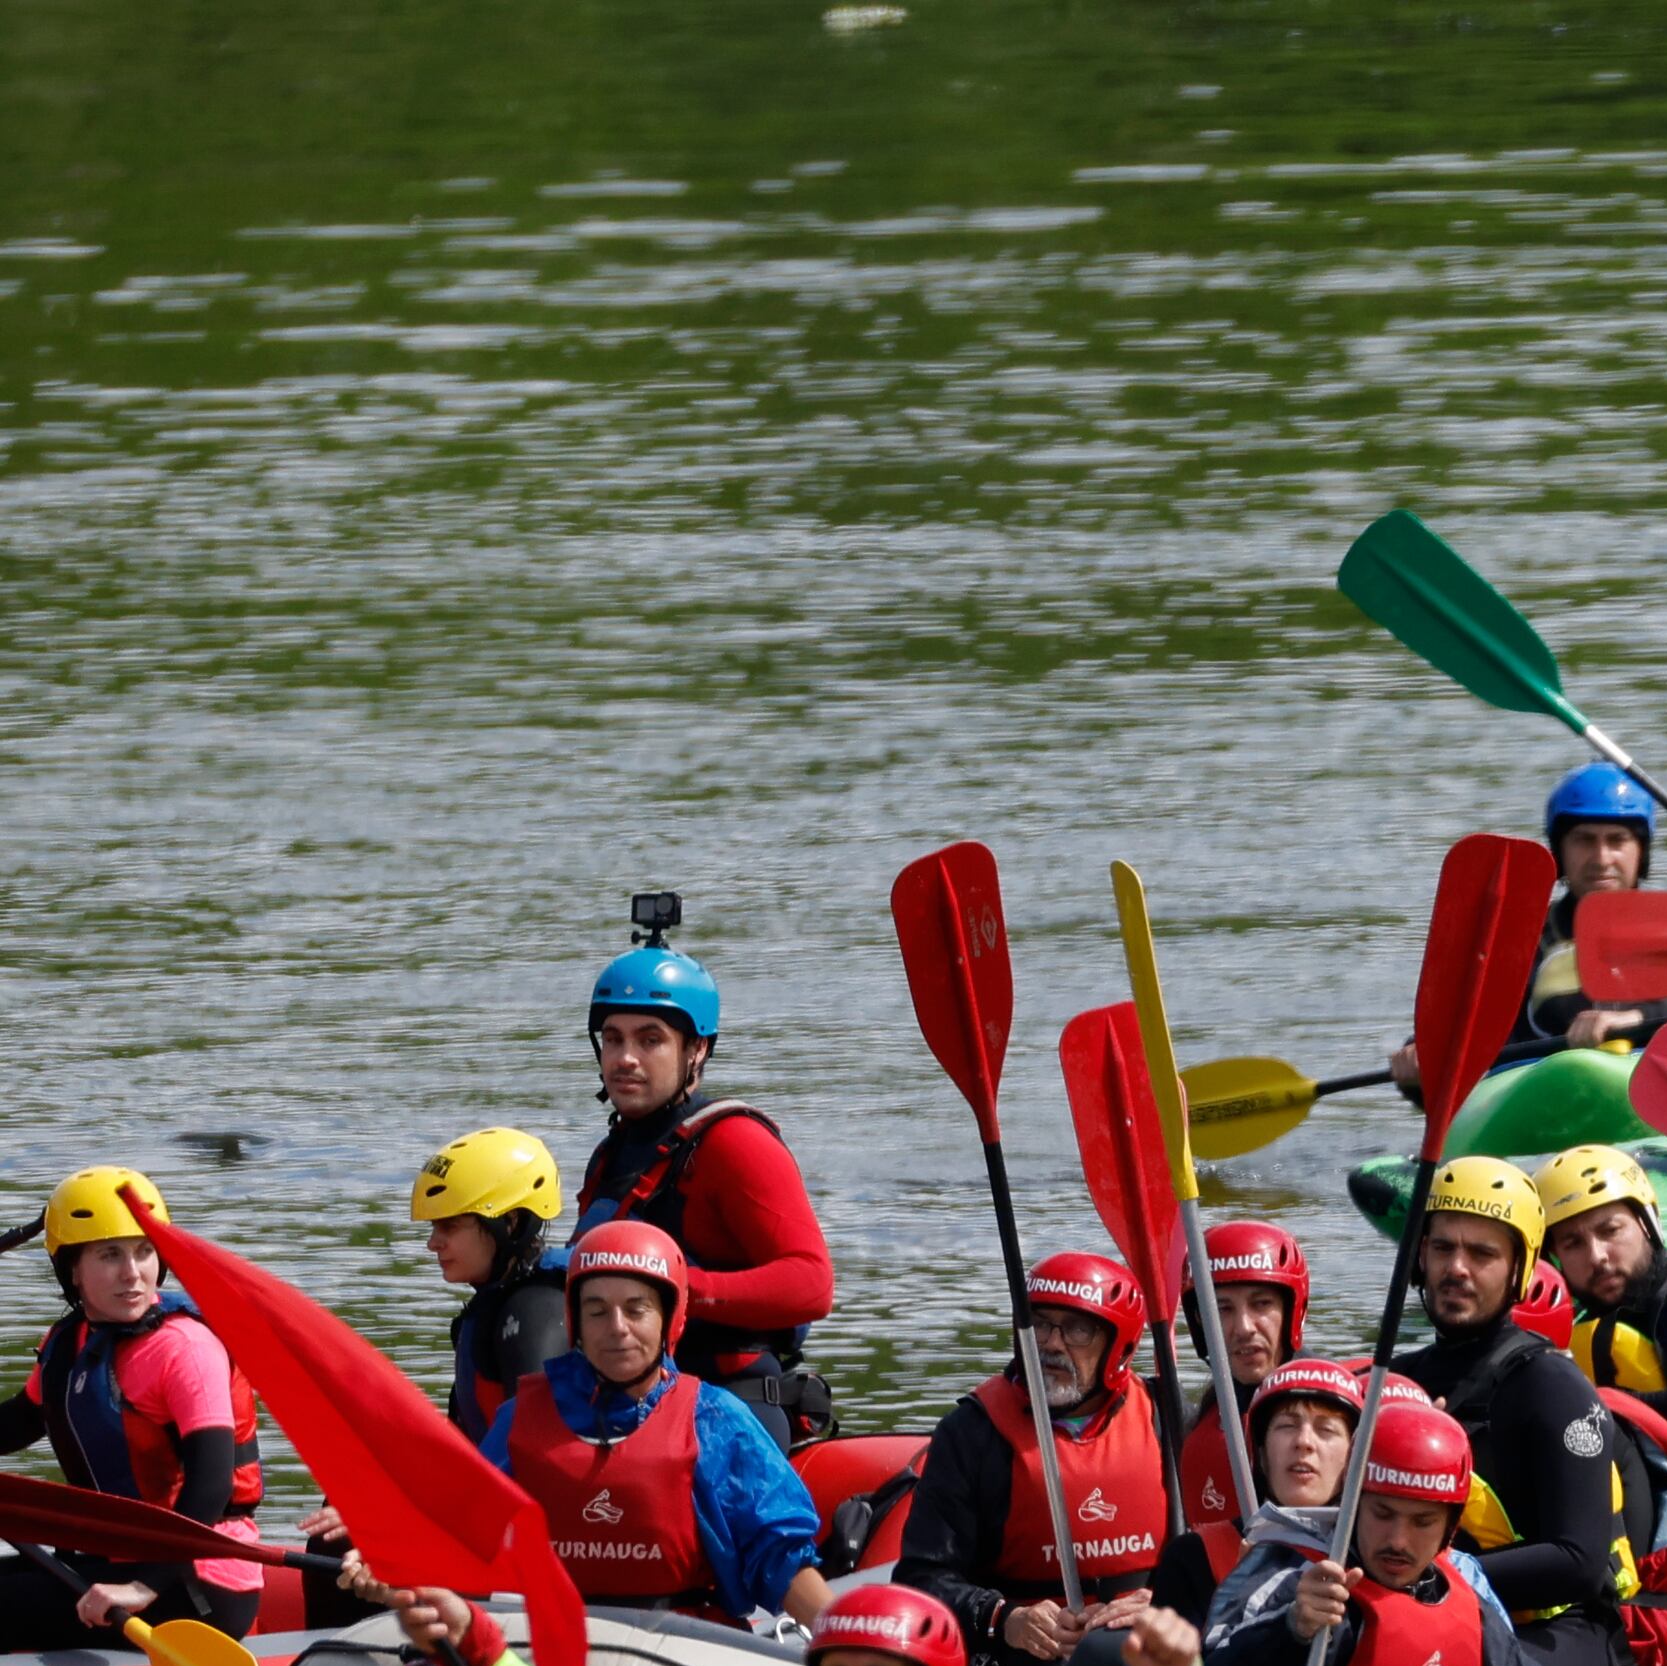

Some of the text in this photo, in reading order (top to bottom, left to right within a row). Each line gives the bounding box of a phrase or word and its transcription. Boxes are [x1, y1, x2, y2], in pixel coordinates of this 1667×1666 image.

[1427, 1193, 1512, 1220] TURNAUGA
[579, 1251, 668, 1278] TURNAUGA
[1188, 1252, 1273, 1273] RNAUGA
[1025, 1276, 1104, 1305] TURNAUGA
[1265, 1368, 1358, 1396] TURNAUGA
[1380, 1381, 1432, 1408] NAUGA
[1367, 1461, 1457, 1492] TURNAUGA
[1041, 1532, 1156, 1563] TRNAUGA
[815, 1612, 910, 1642] TURNAUGA
